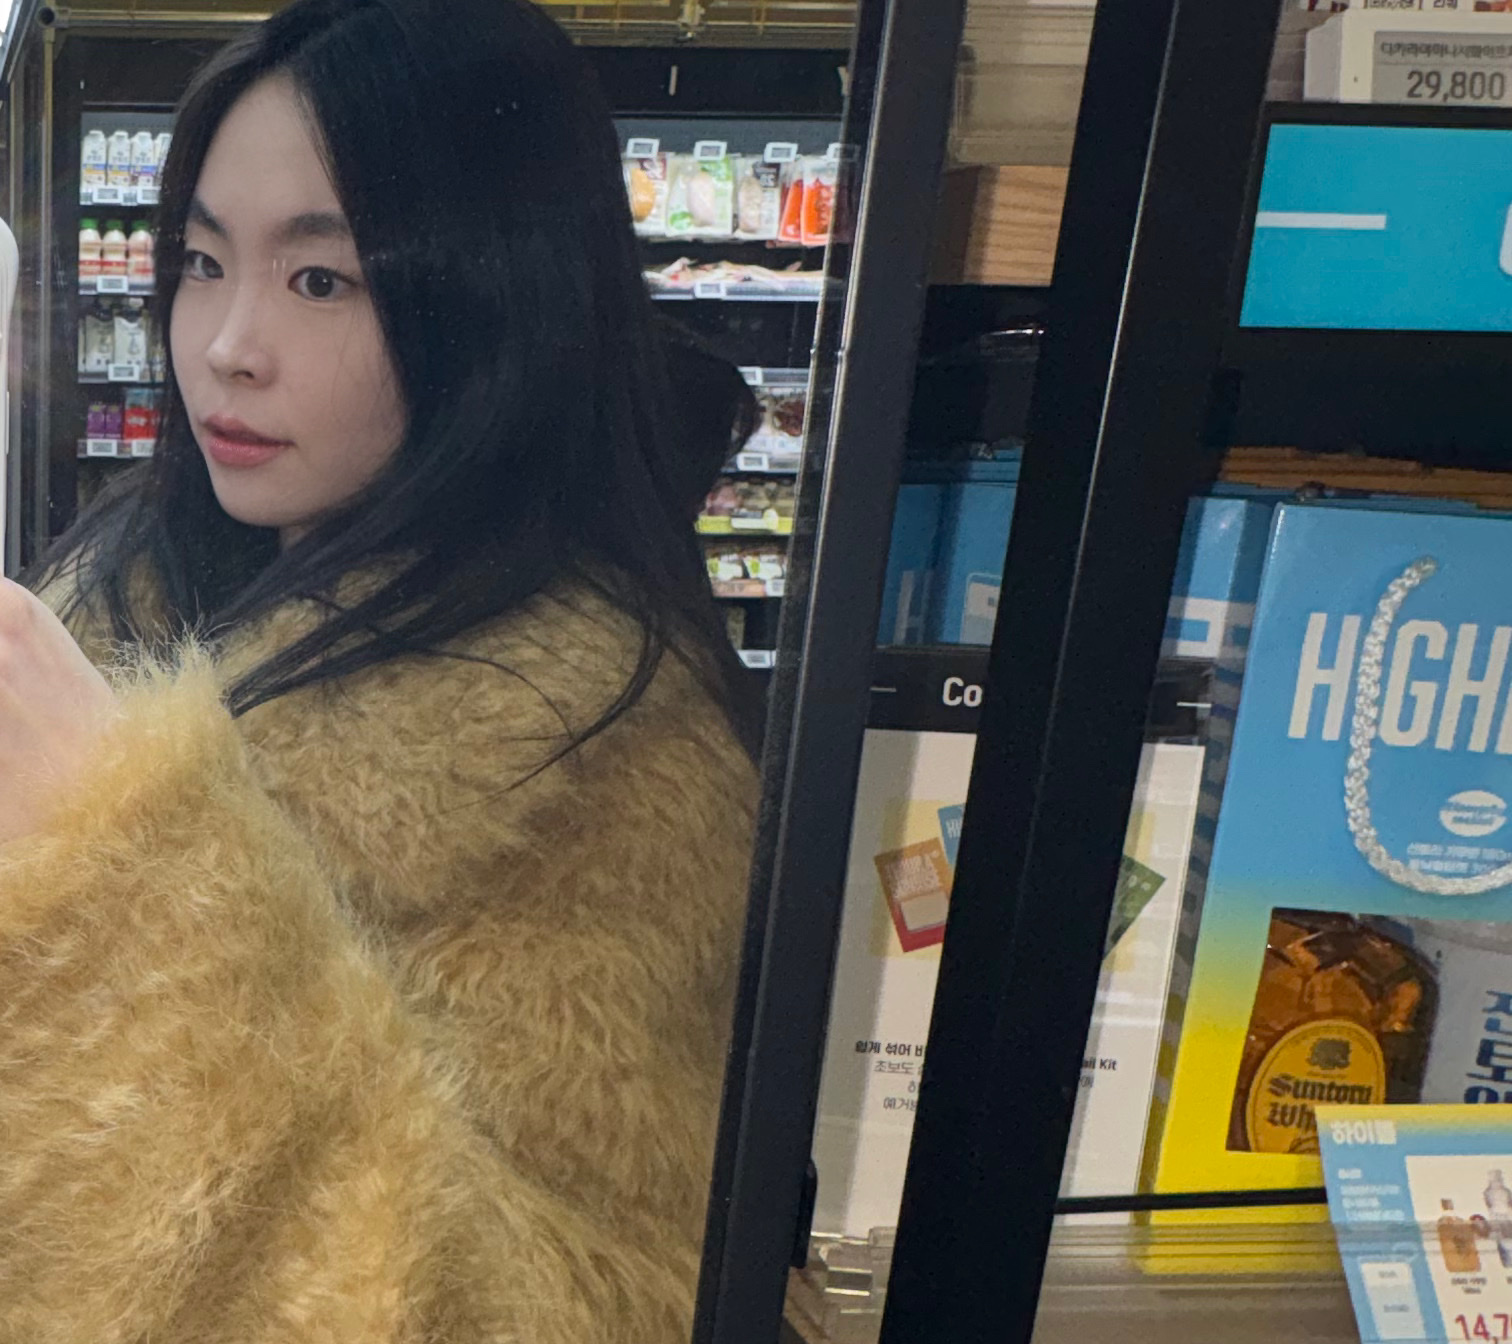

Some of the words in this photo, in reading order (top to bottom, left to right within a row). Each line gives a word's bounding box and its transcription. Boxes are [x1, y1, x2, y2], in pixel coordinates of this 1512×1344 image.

[1407, 70, 1505, 102] 29,800
[1287, 613, 1512, 754] HGH
[1099, 1058, 1117, 1070] Kit
[1269, 1073, 1372, 1103] Suntory
